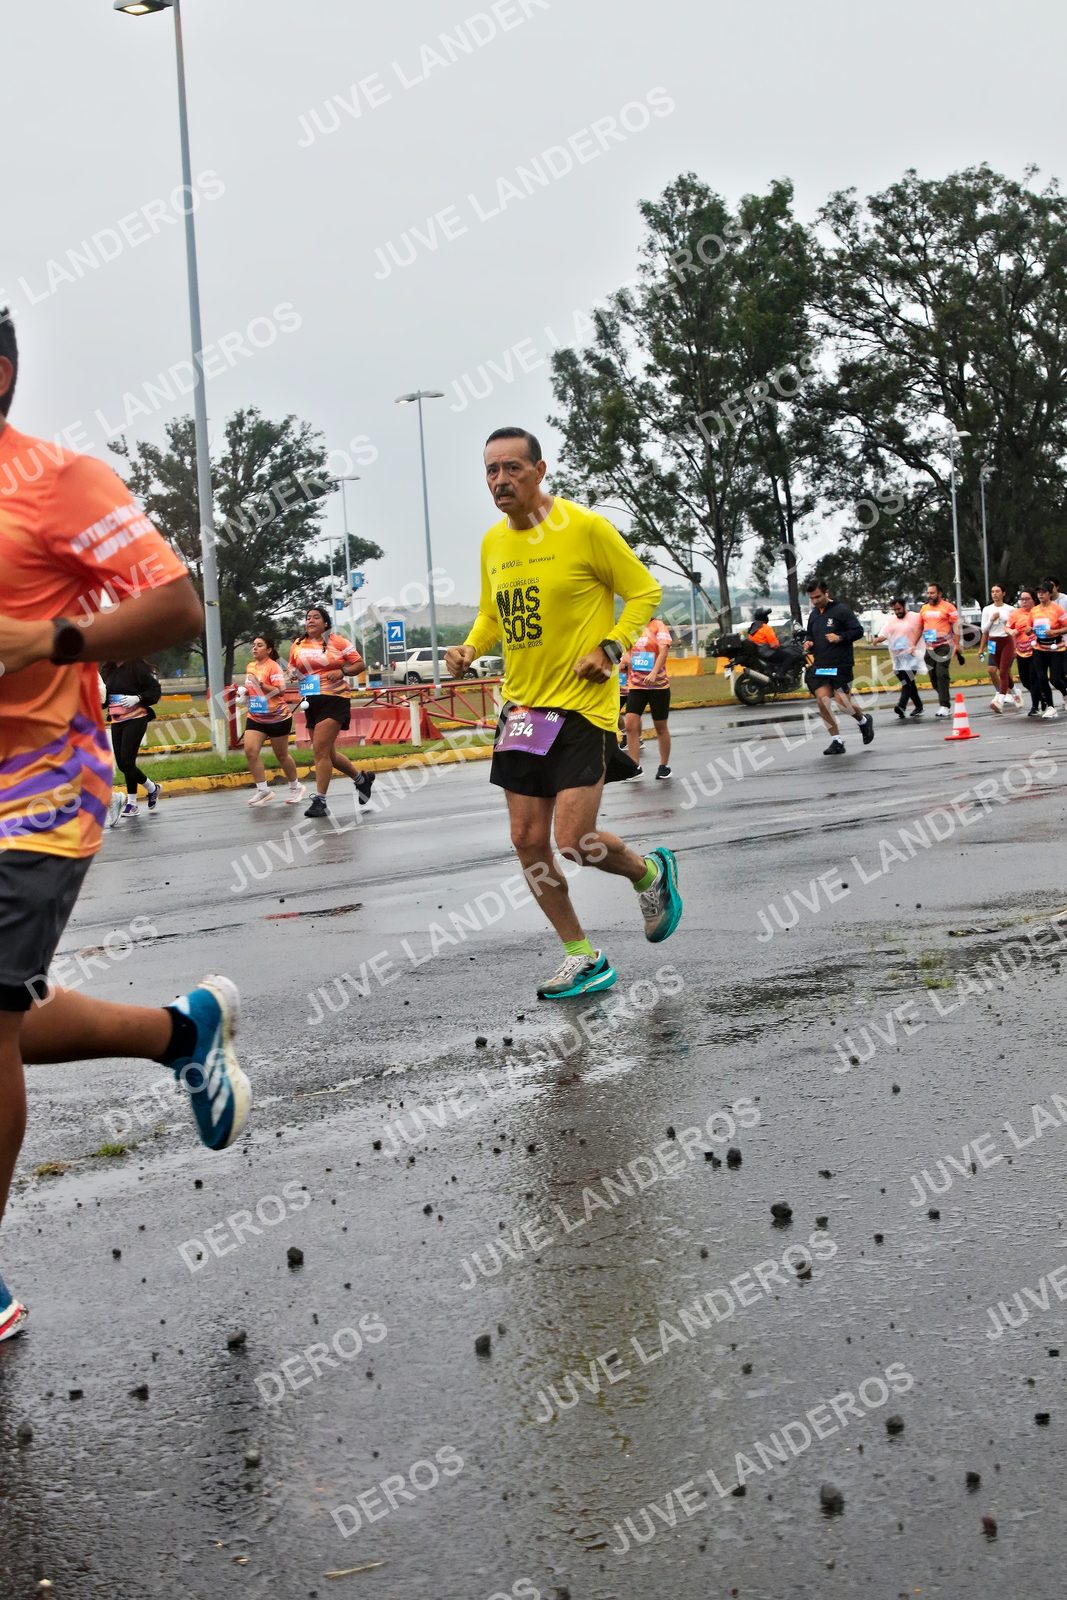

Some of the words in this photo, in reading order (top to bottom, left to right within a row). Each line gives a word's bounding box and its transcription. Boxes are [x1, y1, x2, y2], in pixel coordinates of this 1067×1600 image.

[496, 585, 540, 618] NAS
[502, 612, 543, 644] SOS
[509, 722, 534, 738] 234
